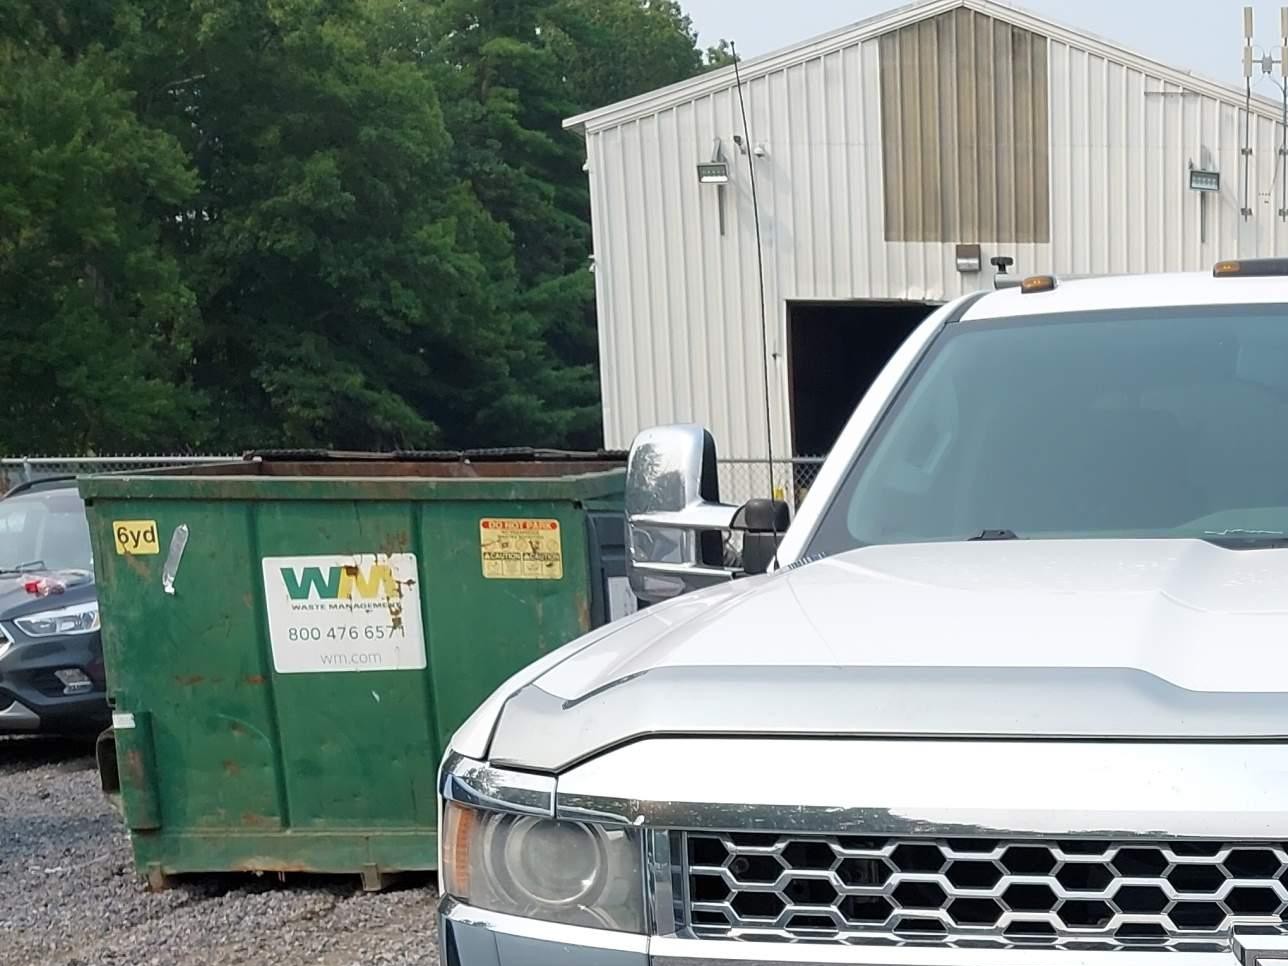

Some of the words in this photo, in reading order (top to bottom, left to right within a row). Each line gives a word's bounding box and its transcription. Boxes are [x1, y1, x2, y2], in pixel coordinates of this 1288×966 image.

[490, 521, 503, 530] DO
[505, 521, 524, 530] NOT
[526, 521, 552, 530] PARK
[117, 525, 156, 549] 6yd
[491, 552, 521, 561] CAUTION
[280, 565, 402, 600] WM
[291, 603, 325, 611] WASTE
[328, 601, 402, 611] MANAGEMENT
[288, 627, 321, 641] 800
[327, 627, 359, 641] 476
[364, 625, 405, 640] 6571
[320, 651, 382, 665] wm.com
